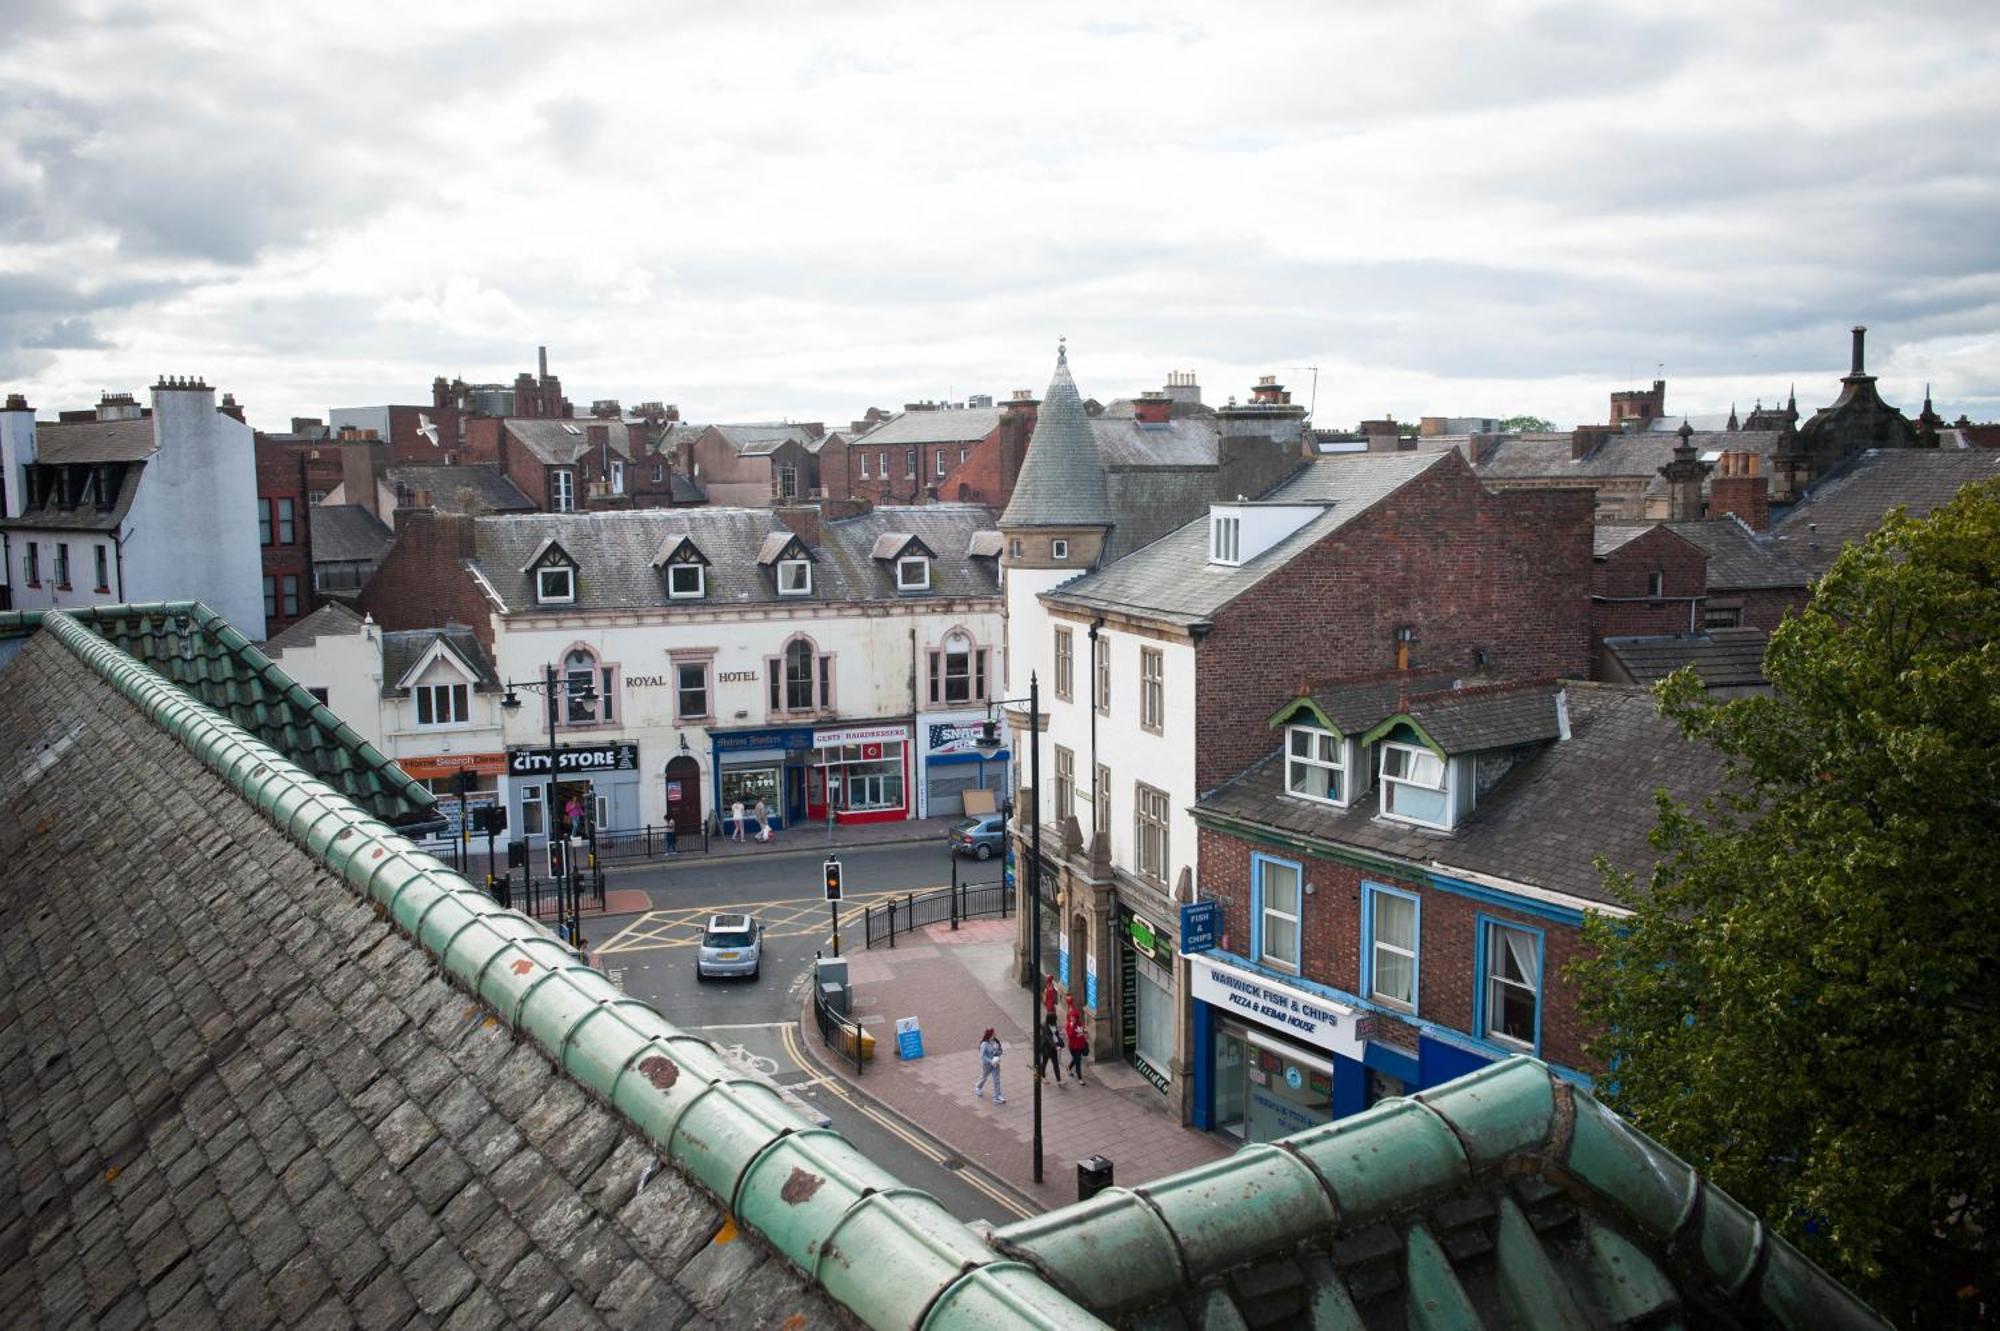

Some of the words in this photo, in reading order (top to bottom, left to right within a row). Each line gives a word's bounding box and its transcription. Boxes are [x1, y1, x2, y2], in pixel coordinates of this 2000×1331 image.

[626, 676, 666, 687] ROYAL
[719, 670, 759, 682] HOTEL
[816, 734, 840, 742] GENTS
[846, 729, 905, 739] HAIRDRESSERS
[513, 755, 552, 770] CITY
[559, 751, 616, 768] STORE
[1191, 913, 1209, 923] FISH
[1188, 932, 1212, 944] CHIPS
[1211, 970, 1260, 996] WARWICK
[1263, 990, 1288, 1008] FISH
[1290, 1000, 1299, 1012] &
[1302, 1004, 1338, 1026] CHIPS
[1229, 993, 1250, 1009] PIZZA
[1252, 1001, 1259, 1012] &
[1260, 1005, 1287, 1022] KEBAB
[1288, 1015, 1317, 1034] HOUSE
